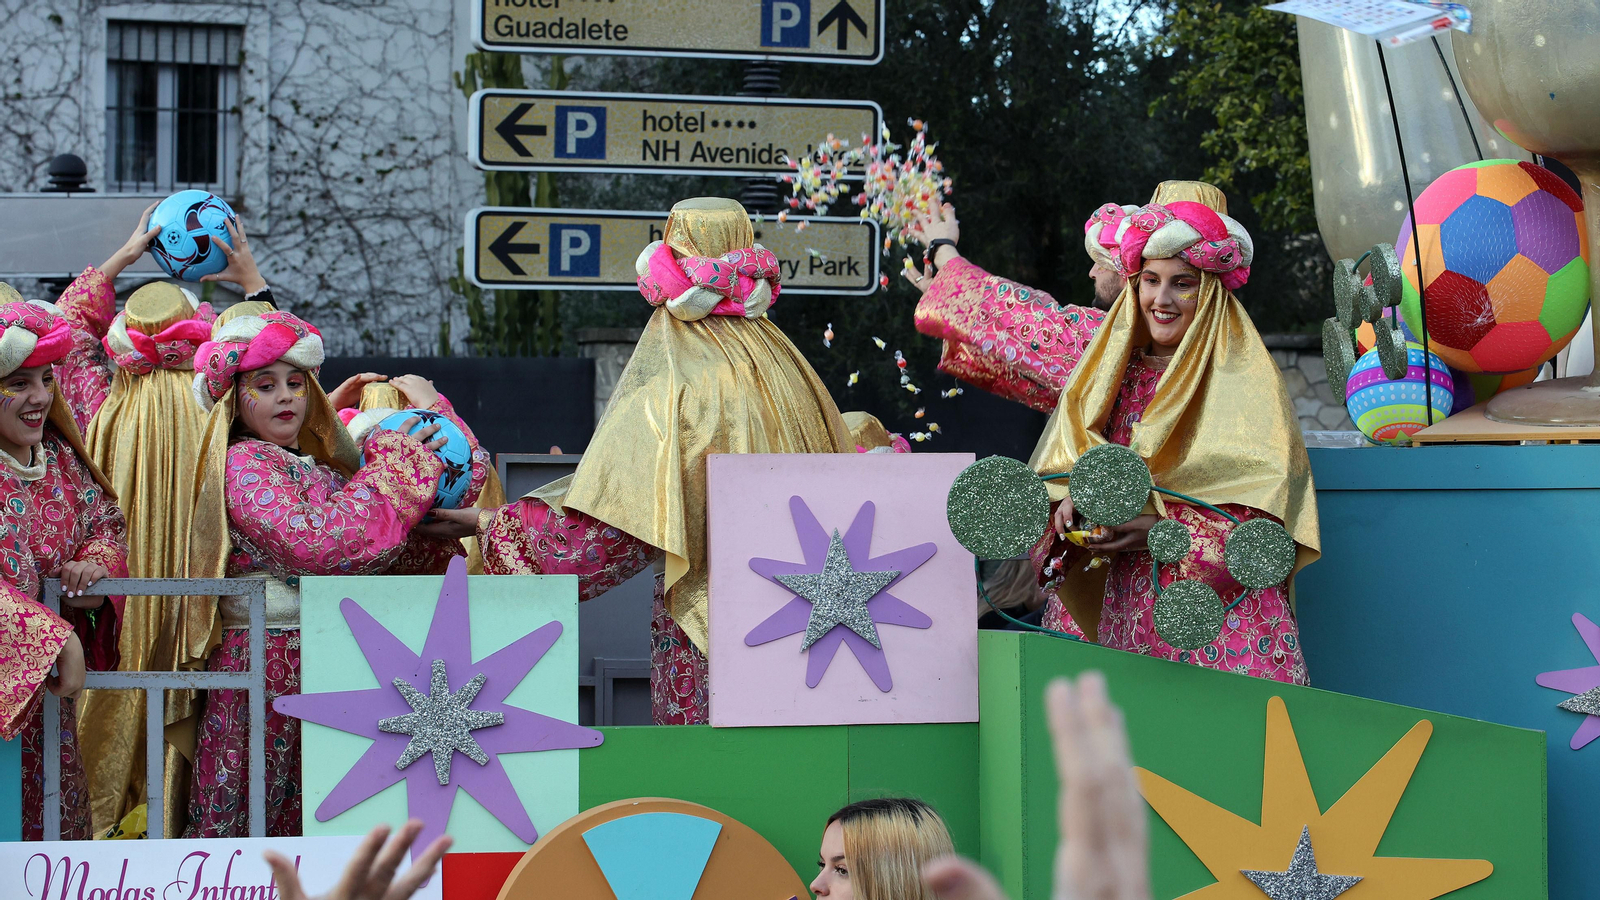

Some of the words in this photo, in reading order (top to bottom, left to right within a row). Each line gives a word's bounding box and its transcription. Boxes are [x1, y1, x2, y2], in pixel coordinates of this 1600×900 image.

[494, 14, 629, 41] Guadalete
[772, 2, 801, 43] P
[566, 111, 598, 154] P
[642, 109, 705, 133] hotel
[642, 139, 680, 162] NH
[689, 141, 789, 165] Avenida
[561, 229, 591, 271] P
[809, 255, 860, 276] Park
[24, 853, 155, 900] Modas
[163, 849, 302, 900] Infant
